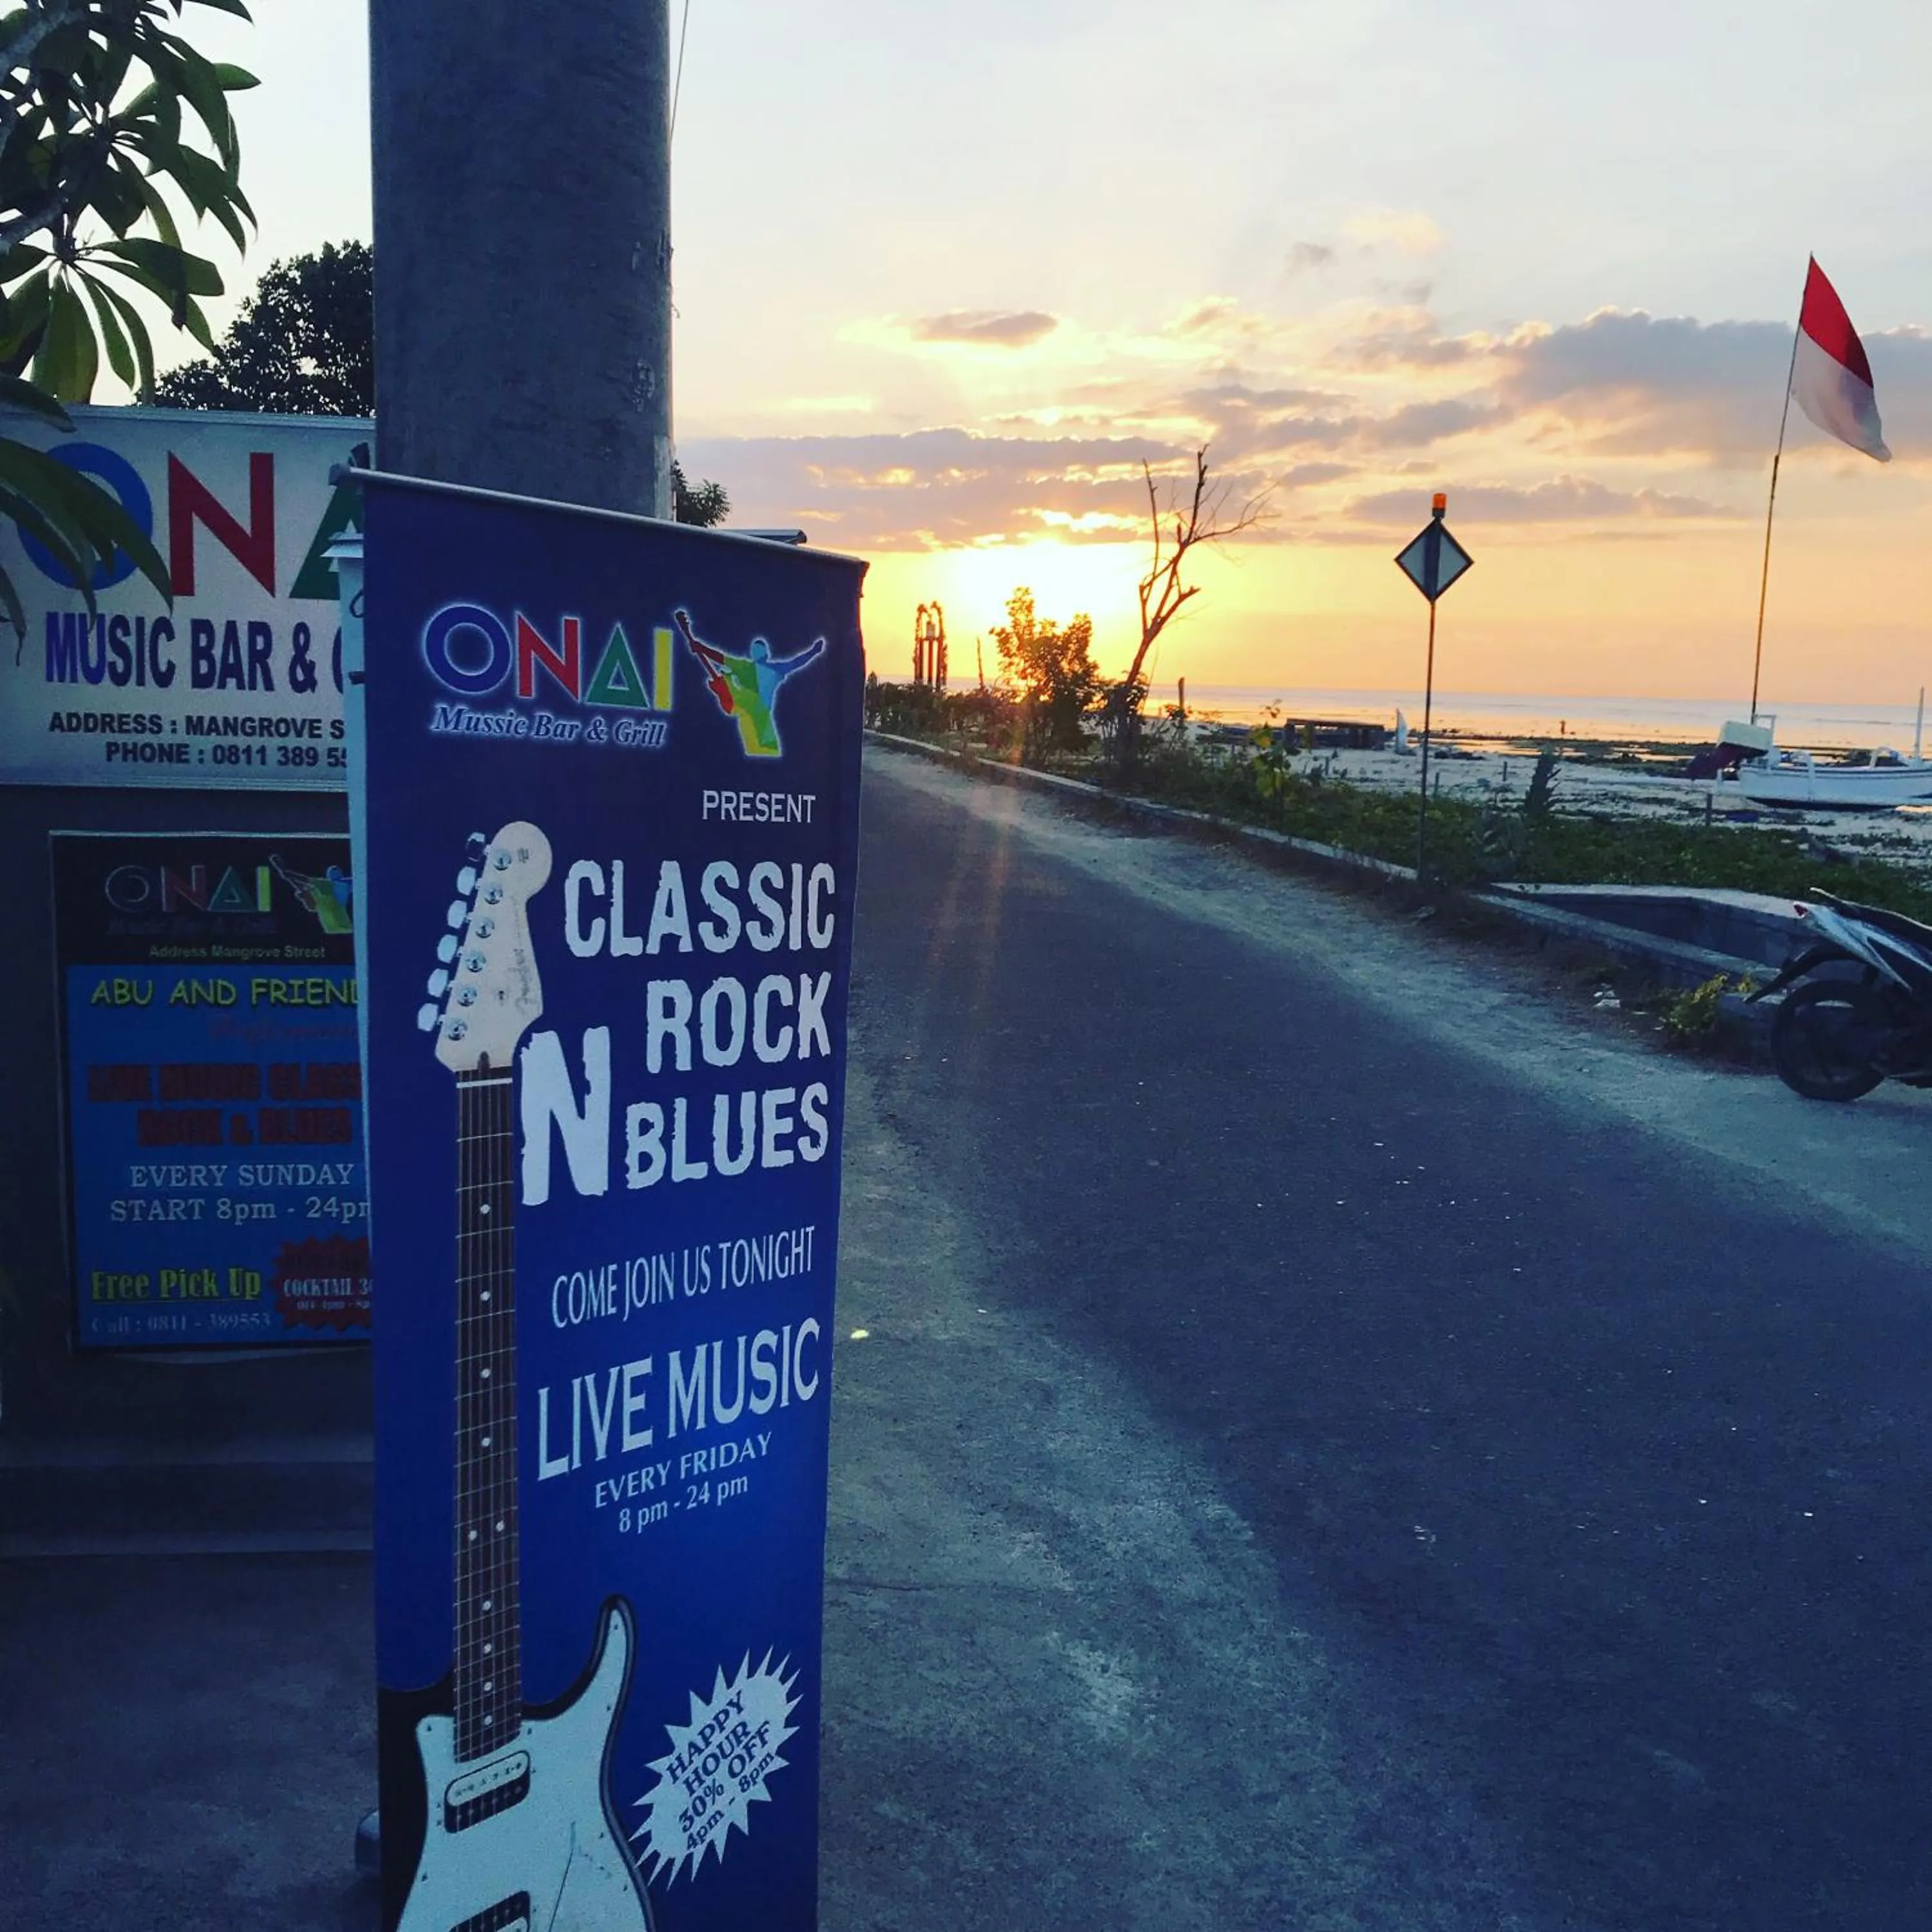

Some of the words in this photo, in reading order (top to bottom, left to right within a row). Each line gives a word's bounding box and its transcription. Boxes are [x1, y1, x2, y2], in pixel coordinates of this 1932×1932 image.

[45, 611, 176, 688] MUSIC
[190, 618, 275, 692] BAR
[289, 621, 317, 694] &
[424, 603, 673, 712] ONAI
[49, 712, 162, 734] ADDRESS
[185, 715, 322, 739] MANGROVE
[106, 743, 190, 763] PHONE
[213, 745, 267, 766] 0811
[277, 746, 317, 766] 389
[430, 705, 528, 737] Mussic
[533, 712, 581, 741] Bar
[586, 717, 607, 743] &
[614, 719, 666, 747] Grill
[703, 790, 817, 824] PRESENT
[105, 864, 272, 913] ONAI
[564, 860, 836, 958] CLASSIC
[149, 945, 206, 958] Address
[211, 945, 280, 960] Mangrove
[284, 945, 326, 958] Street
[91, 978, 153, 1005] ABU
[169, 978, 236, 1005] AND
[646, 971, 832, 1074] ROCK
[520, 1026, 611, 1206] N
[624, 1082, 829, 1190] BLUES
[111, 1198, 205, 1222] START
[216, 1198, 277, 1225] 8pm
[131, 1164, 227, 1188] EVERY
[238, 1163, 354, 1186] SUNDAY
[92, 1270, 149, 1300] Free
[160, 1268, 219, 1298] Pick
[228, 1266, 261, 1300] Up
[552, 1264, 618, 1329] COME
[623, 1251, 675, 1321] JOIN
[683, 1244, 712, 1296] US
[718, 1226, 815, 1290] TONIGHT
[537, 1355, 653, 1481] LIVE
[667, 1317, 820, 1439] MUSIC
[594, 1460, 672, 1509] EVERY
[679, 1432, 773, 1481] FRIDAY
[619, 1508, 631, 1533] 8
[637, 1501, 668, 1534] pm
[687, 1484, 710, 1510] 24
[717, 1475, 749, 1506] pm
[666, 1689, 744, 1785] HAPPY
[683, 1721, 751, 1797] HOUR
[678, 1777, 724, 1833] 30%
[728, 1720, 770, 1779] OFF
[686, 1809, 725, 1852] 4pm
[737, 1751, 775, 1794] 8pm
